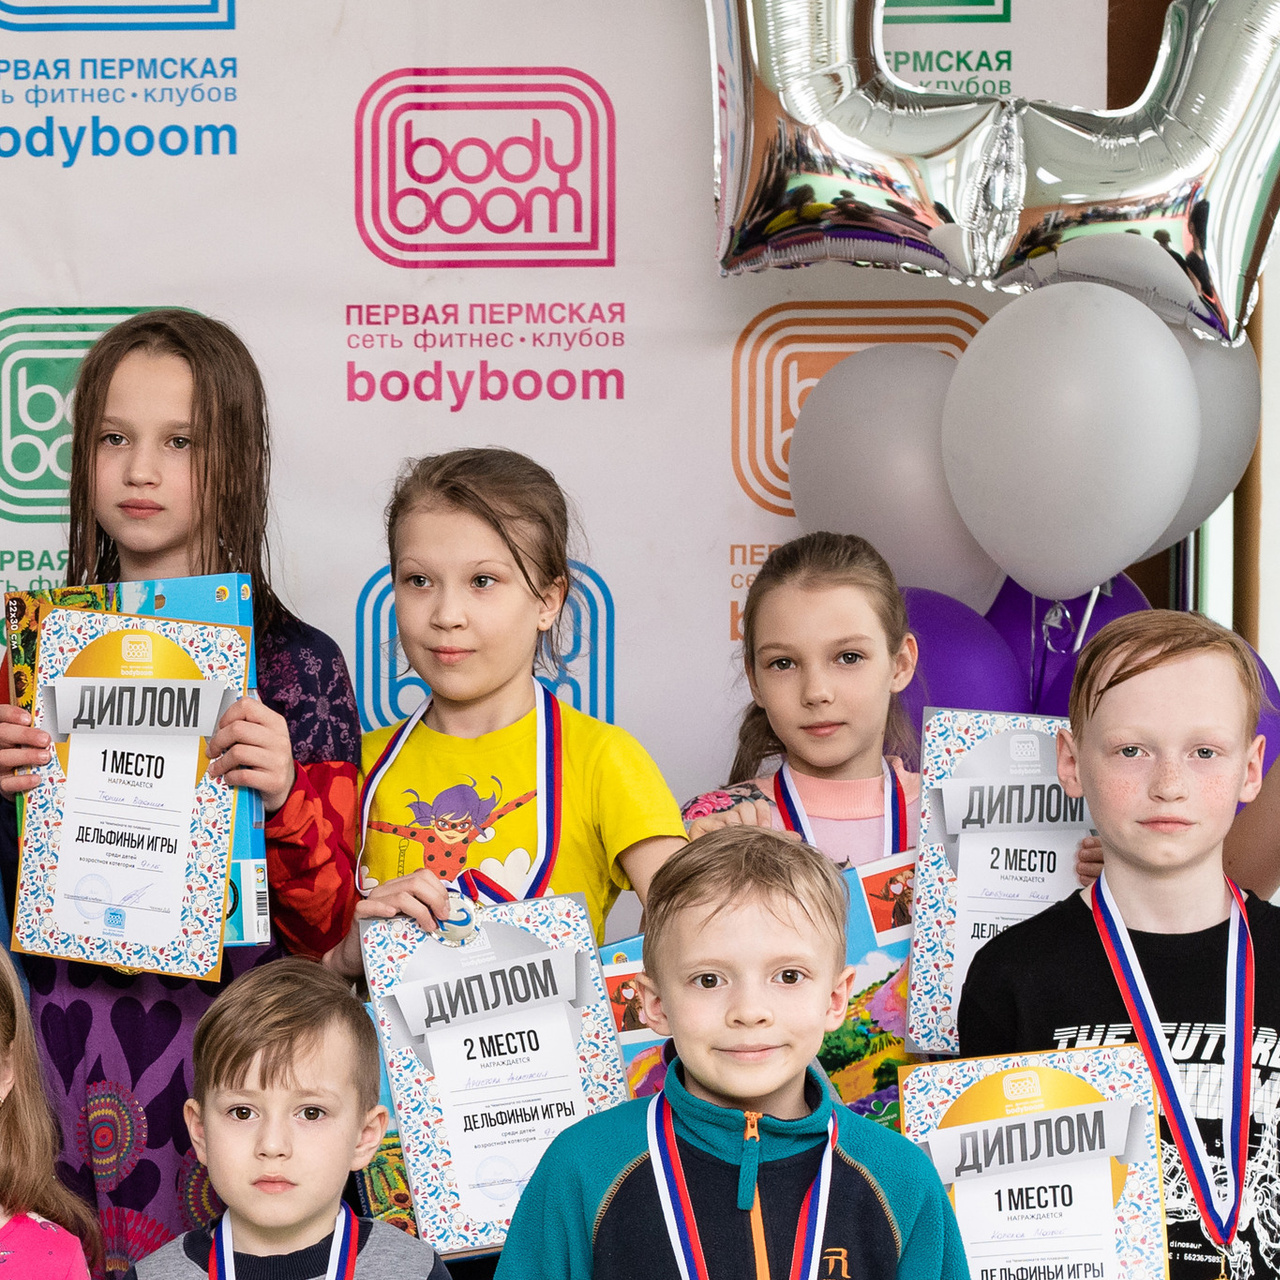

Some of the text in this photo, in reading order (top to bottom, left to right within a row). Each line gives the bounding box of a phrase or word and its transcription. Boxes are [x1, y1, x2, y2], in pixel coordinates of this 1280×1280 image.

[80, 57, 238, 80] ПЕРМСКАЯ
[884, 50, 1012, 72] РМСКАЯ
[405, 117, 582, 184] body
[388, 185, 582, 235] boom
[346, 302, 626, 327] ПЕРВАЯ ПЕРМСКАЯ
[346, 331, 404, 349] сеть
[346, 361, 626, 412] bodyboom
[121, 669, 153, 677] bodyboom
[73, 685, 200, 730] ДИПЛОМ
[101, 749, 164, 779] 1 МЕСТО
[108, 778, 153, 788] НАГРАЖДАЕТСЯ
[962, 783, 1084, 829] ДИПЛОМ
[75, 826, 177, 855] ДЕЛЬФИНЬИ ИГРЫ
[990, 847, 1057, 873] 2 МЕСТО
[1000, 874, 1045, 883] НАГРАЖДАЕТСЯ
[424, 959, 559, 1028] ДИПЛОМ
[464, 1029, 540, 1061] 2 МЕСТО
[1053, 1025, 1132, 1050] THE
[480, 1057, 531, 1069] НАГРАЖДАЕТСЯ
[463, 1101, 575, 1133] ДЕЛЬФИНЬИ ИГРЫ
[955, 1110, 1106, 1177] ДИПЛОМ
[994, 1184, 1073, 1212] 1 МЕСТО
[1007, 1212, 1063, 1221] НАГРАЖДАЕТСЯ
[1170, 1240, 1202, 1249] dinosaur
[1067, 1262, 1104, 1279] ИГРЫ
